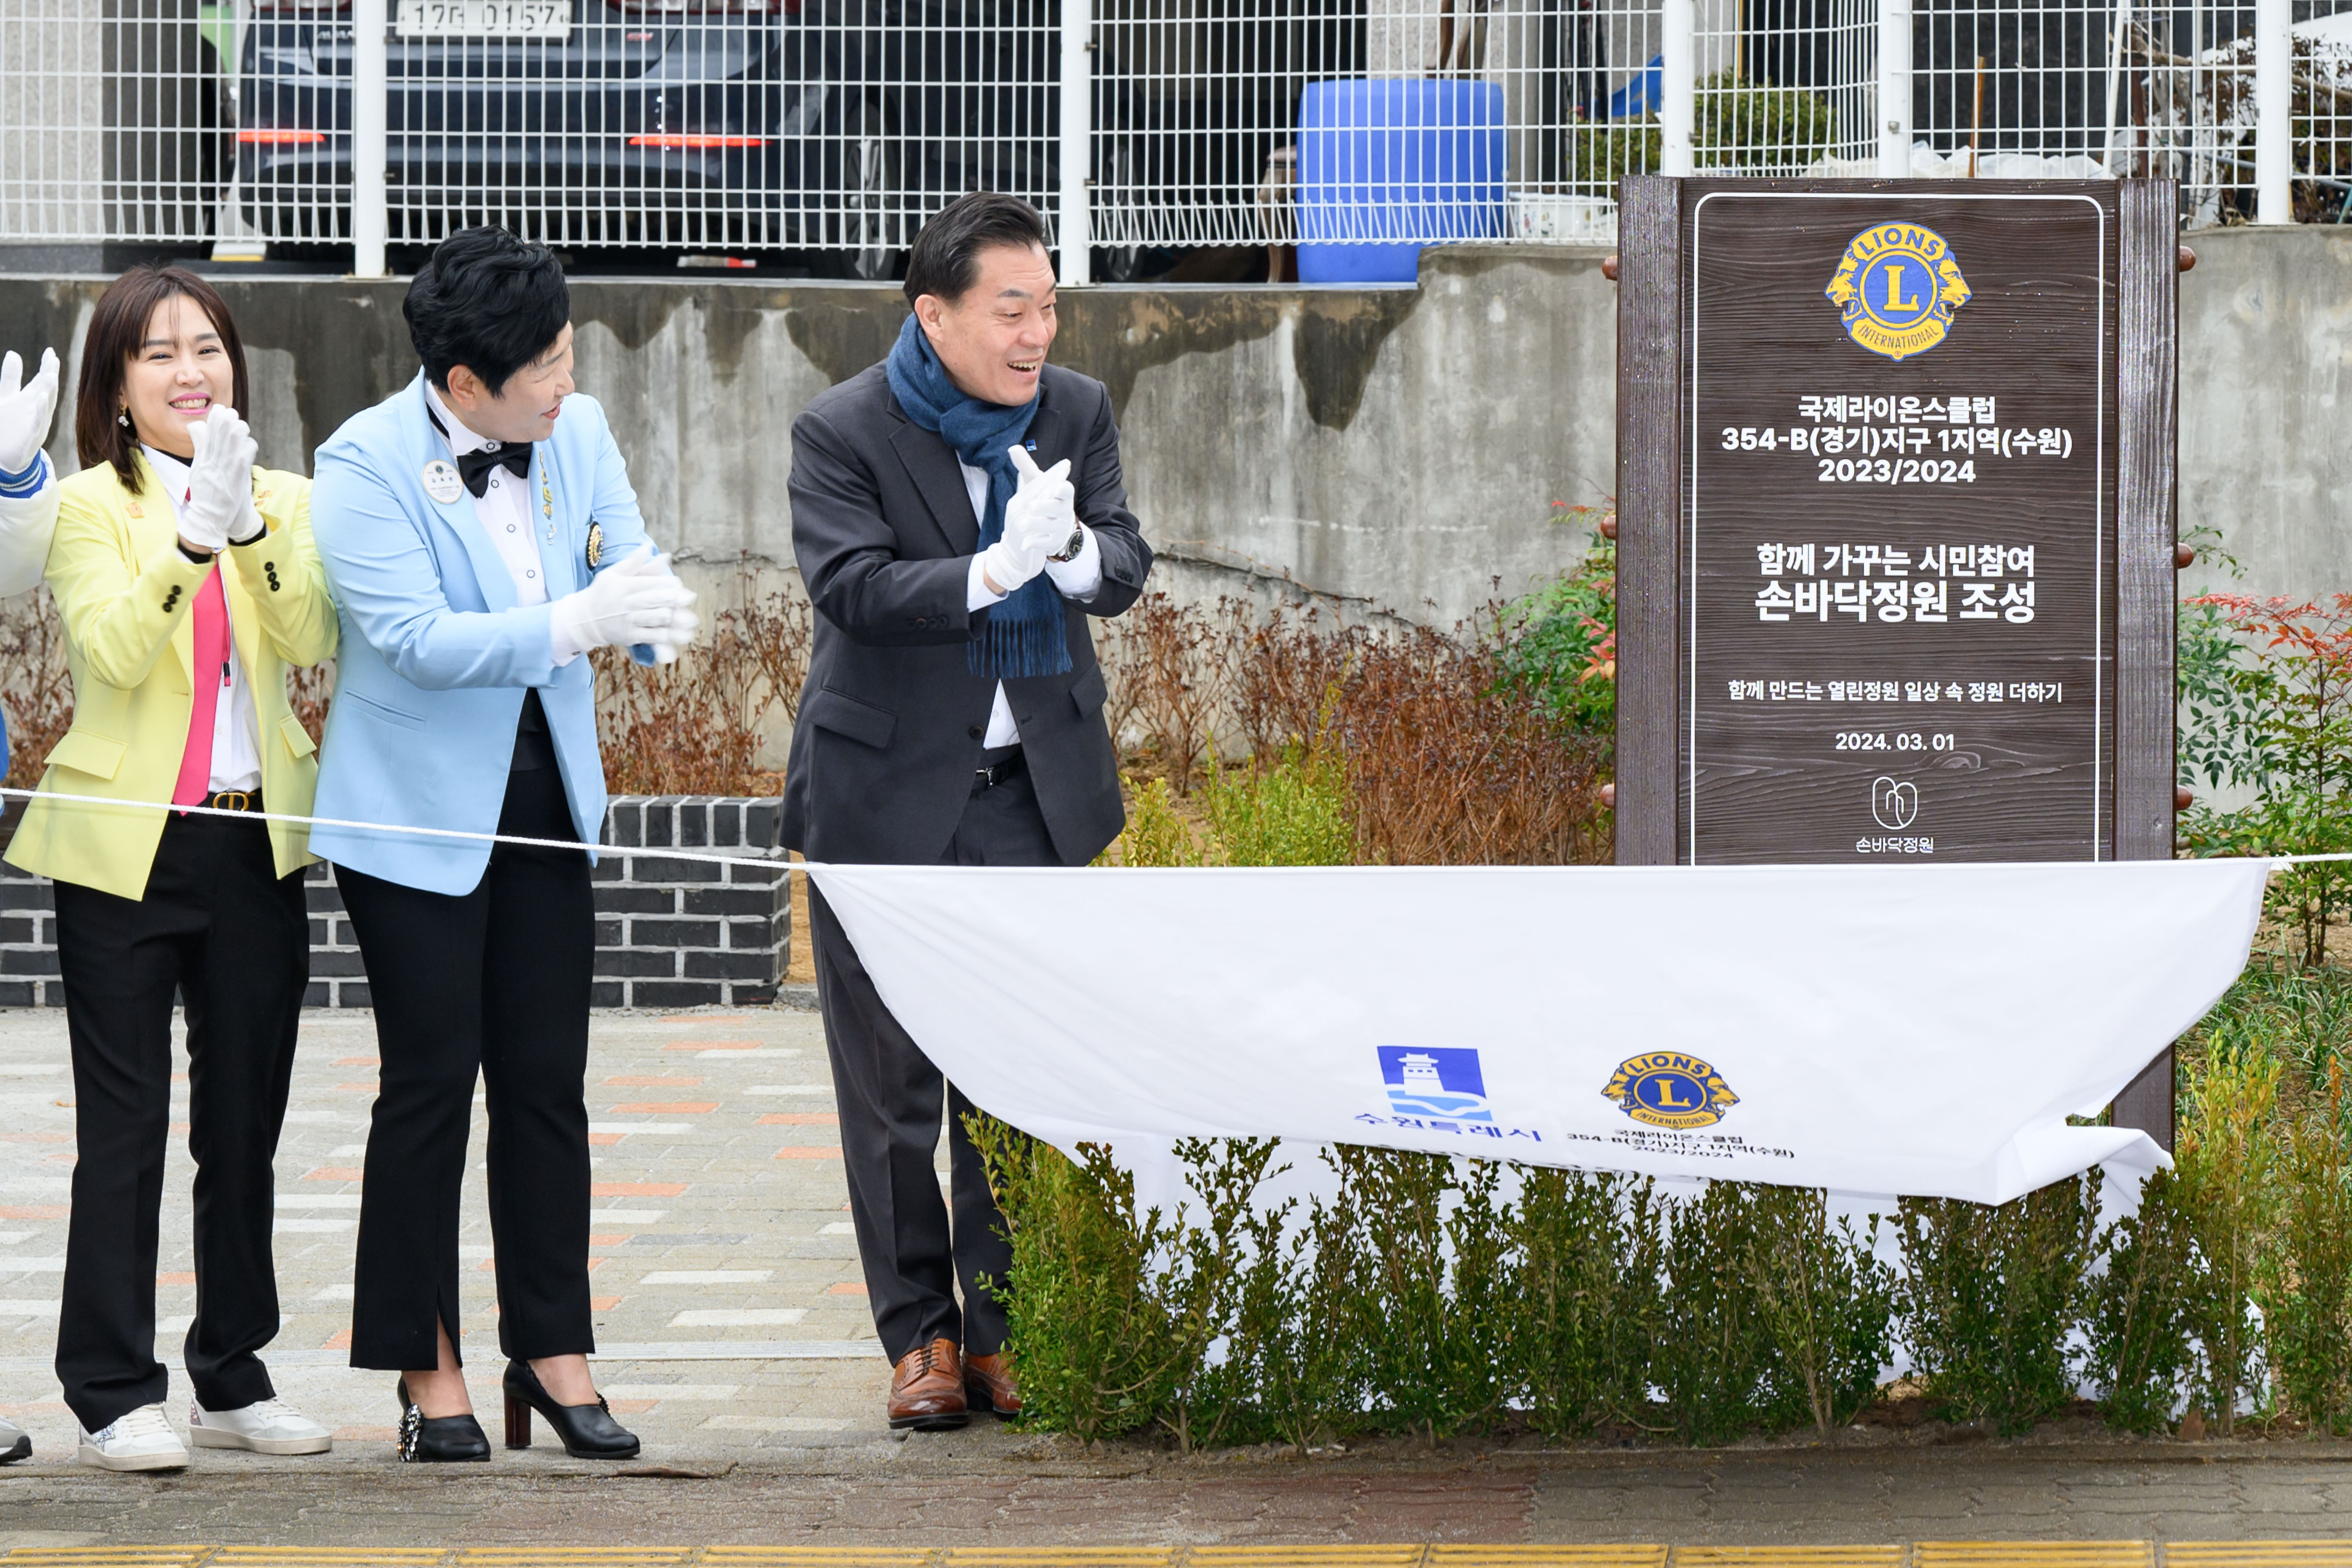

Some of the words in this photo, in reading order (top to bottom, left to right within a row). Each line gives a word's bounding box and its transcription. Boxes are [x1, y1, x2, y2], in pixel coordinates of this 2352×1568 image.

[482, 4, 555, 31] 0157
[1858, 227, 1940, 256] LIONS
[1883, 265, 1920, 311] L
[1857, 324, 1939, 349] INTERNATIONAL
[1798, 395, 1995, 424] 국제라이온스클럽
[1722, 426, 1931, 456] 354-B(경기)지구
[1938, 428, 2072, 457] 1지역(수원)
[1818, 459, 1976, 485] 2023/2024
[1757, 543, 1815, 575] 함께
[1823, 543, 1911, 577] 가꾸는
[1918, 544, 2034, 577] 시민참여
[1755, 579, 1947, 622] 손바닥정원
[1959, 580, 2035, 623] 조성
[1728, 680, 1764, 700] 함께
[1769, 680, 1823, 701] 만드는
[1828, 681, 1899, 701] 열린정원
[1904, 681, 1940, 702] 일상
[1945, 681, 1963, 702] 속
[1968, 681, 2003, 702] 정원
[2009, 681, 2062, 703] 더하기
[1835, 733, 1891, 750] 2024.
[1896, 733, 1927, 750] 03.
[1932, 733, 1954, 750] 01
[1855, 837, 1933, 853] 손바닥정원
[1628, 1055, 1706, 1075] LIONS
[1655, 1078, 1691, 1107] L
[1354, 1113, 1543, 1142] 수원특례시
[1636, 1111, 1713, 1126] INTERNATIONAL
[1566, 1133, 1702, 1150] 354-B(경기)지구
[1707, 1143, 1795, 1159] 1지역(수원)
[1615, 1128, 1743, 1144] 국제라이온스클럽
[1632, 1145, 1735, 1159] 2023/2024
